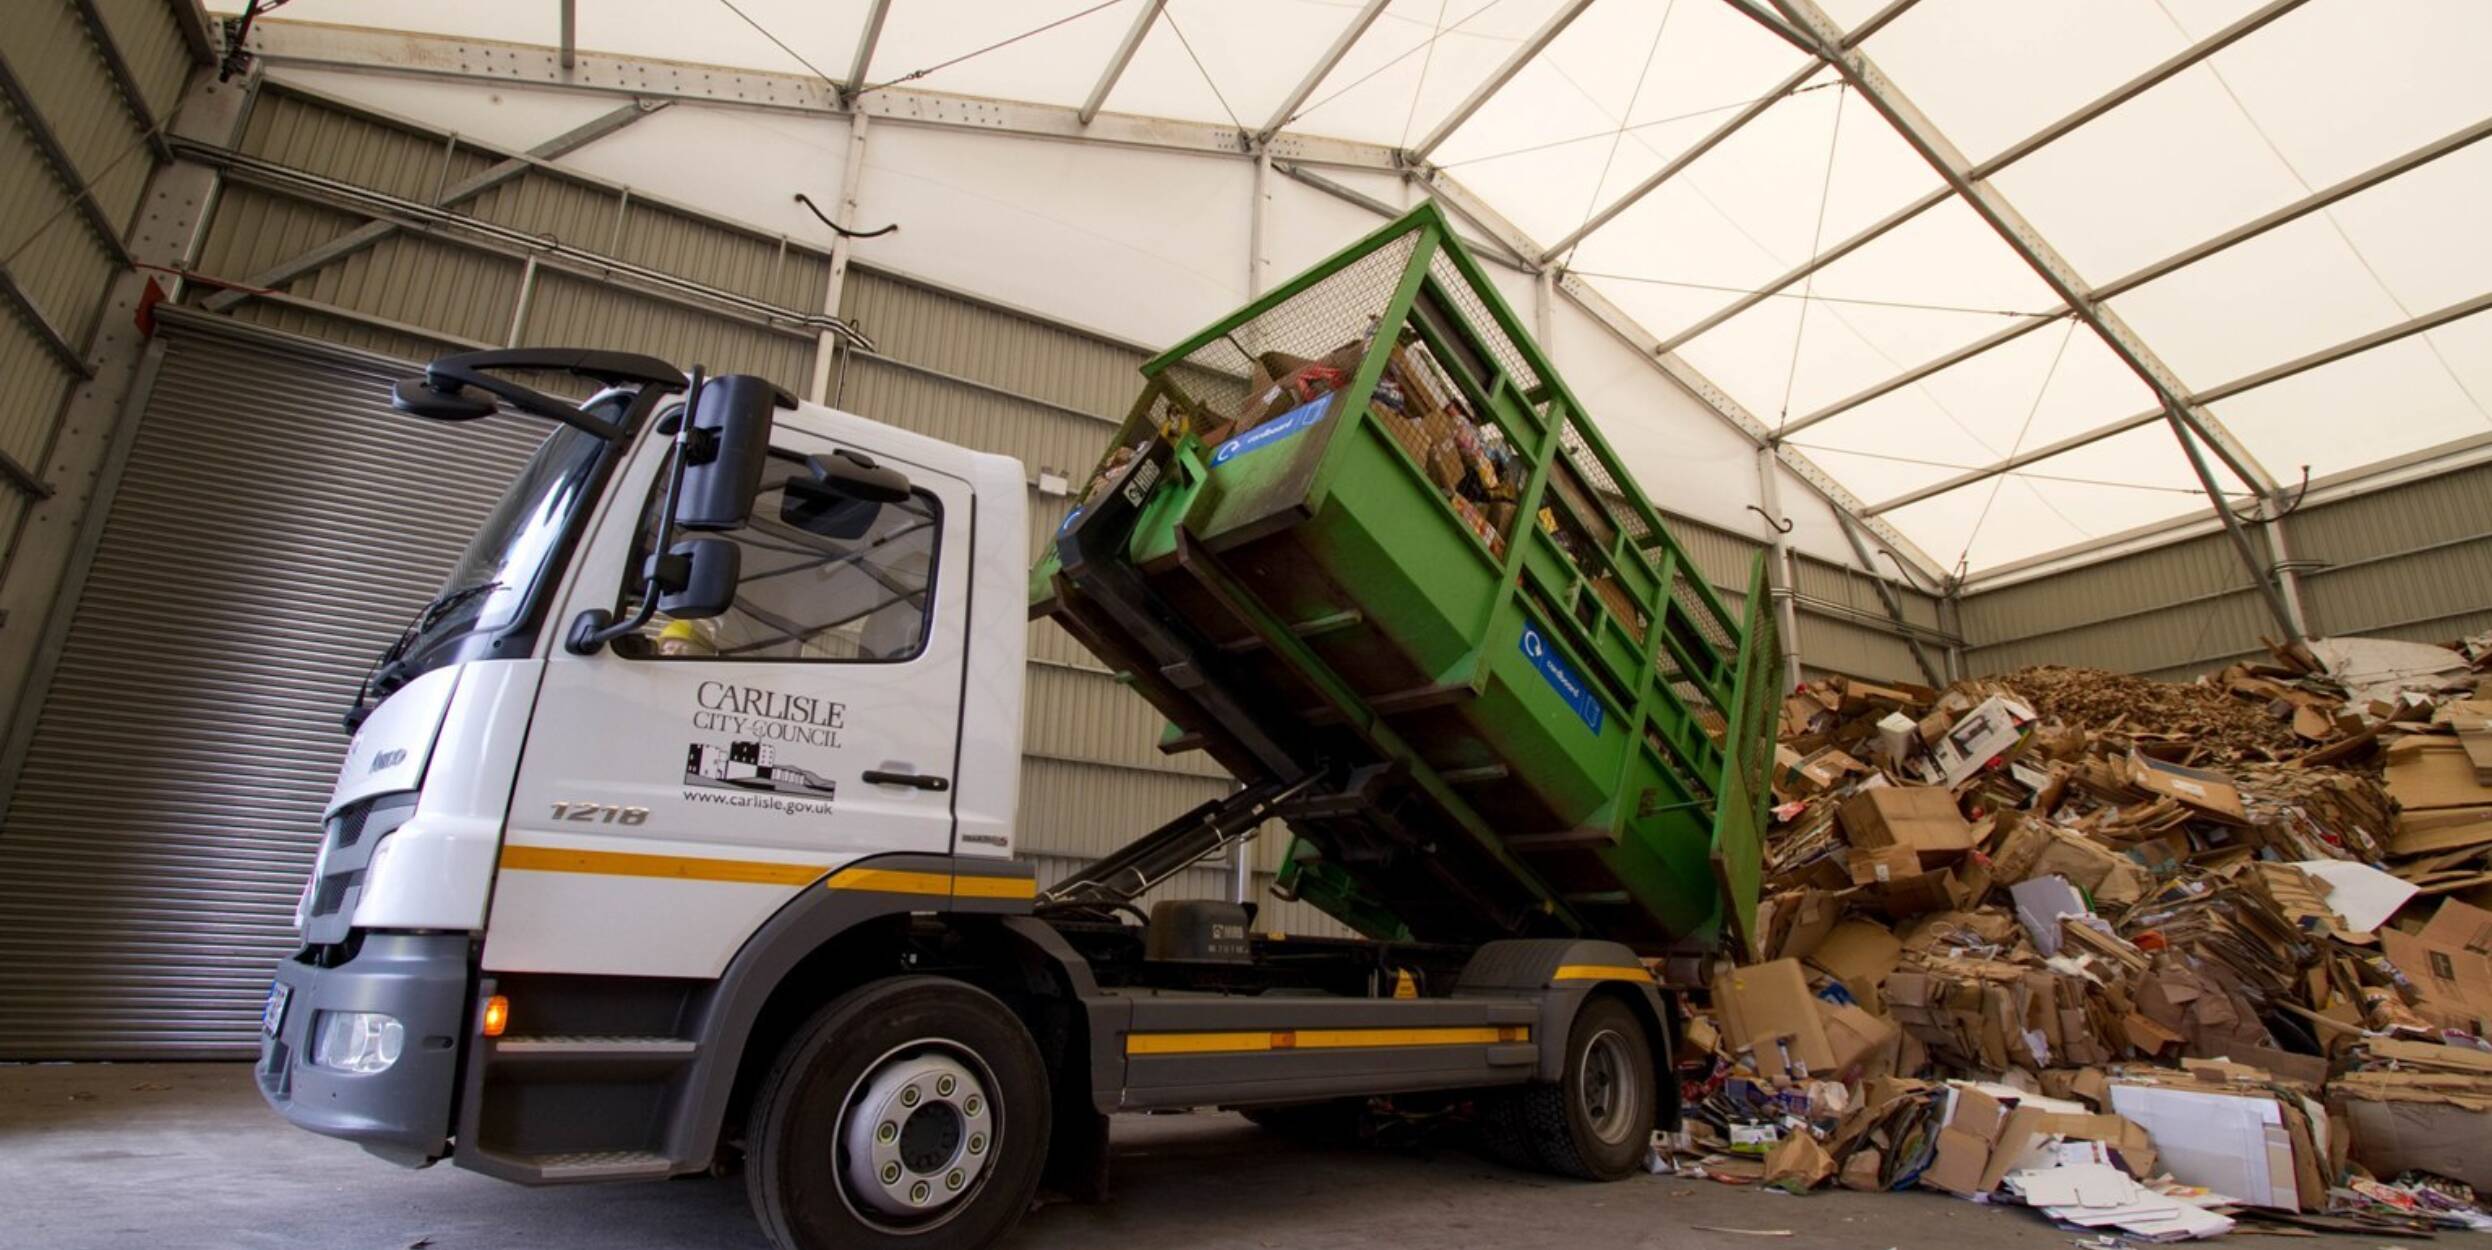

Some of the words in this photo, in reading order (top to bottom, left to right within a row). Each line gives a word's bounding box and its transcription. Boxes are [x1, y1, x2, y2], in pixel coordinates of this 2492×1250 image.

[697, 680, 847, 729] CARLISLE
[693, 710, 747, 734] CITY
[752, 719, 842, 749] COUNCIL
[550, 801, 650, 826] 1218
[682, 790, 833, 816] www.carlisle.gov.uk
